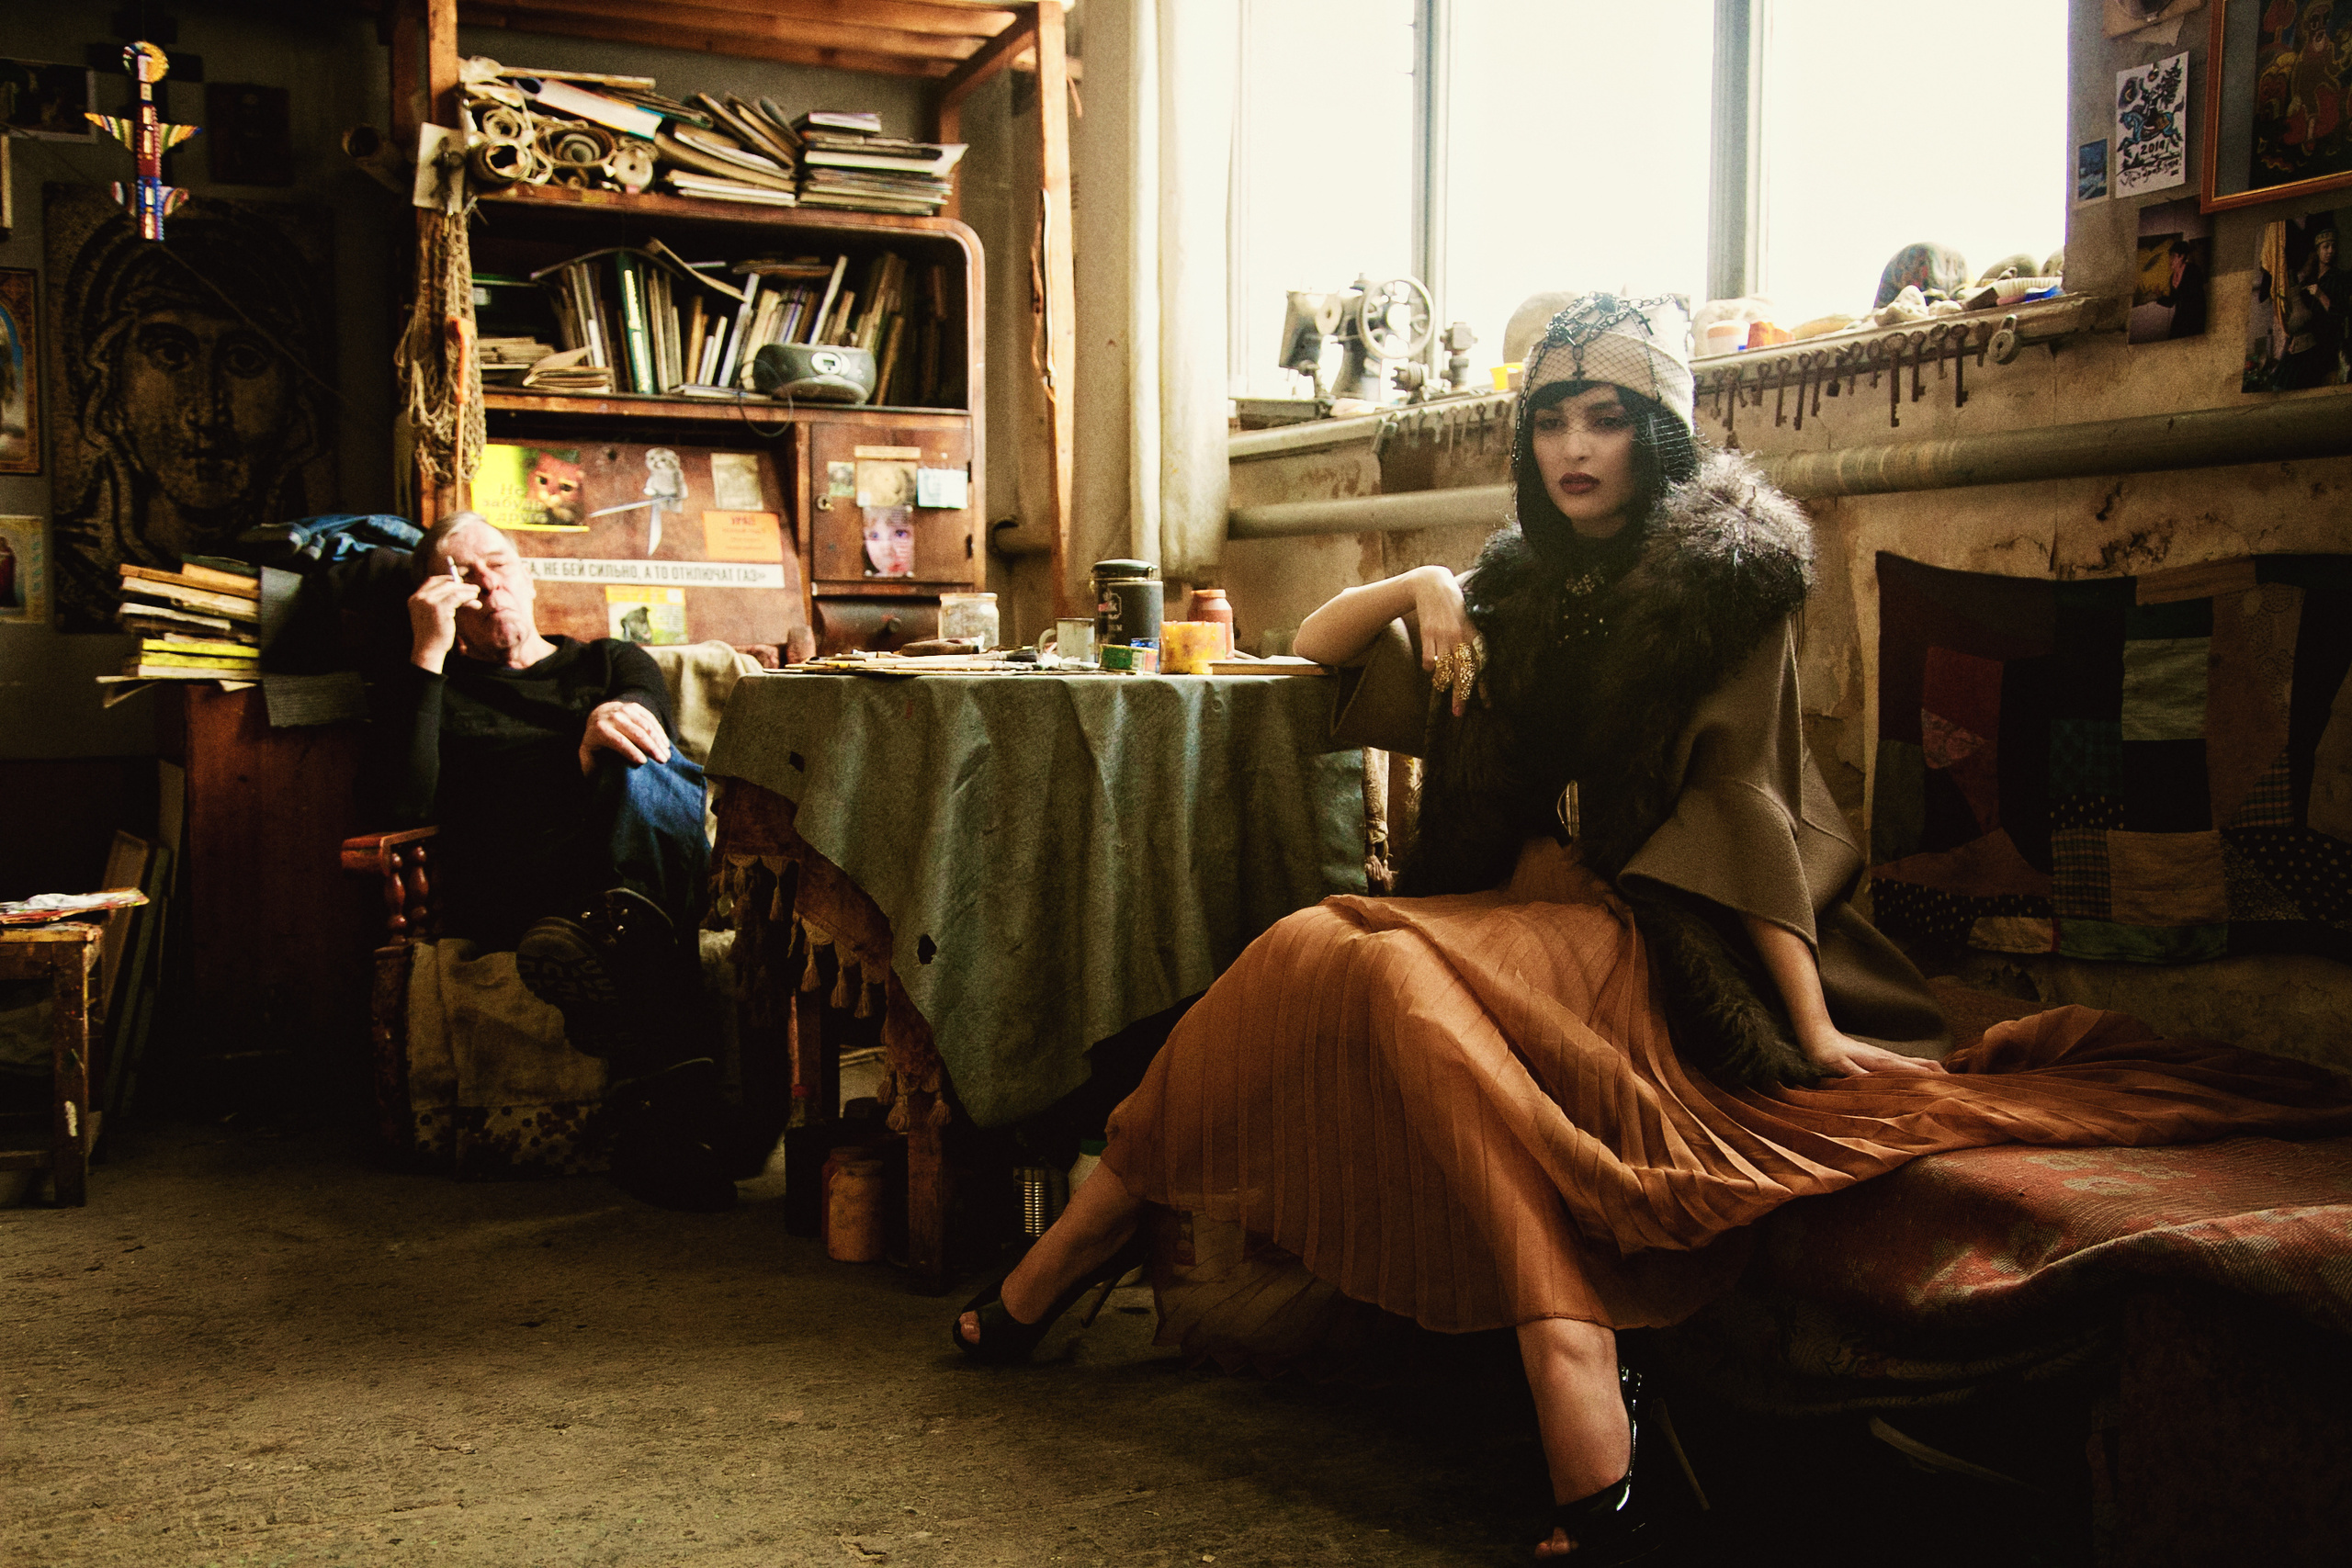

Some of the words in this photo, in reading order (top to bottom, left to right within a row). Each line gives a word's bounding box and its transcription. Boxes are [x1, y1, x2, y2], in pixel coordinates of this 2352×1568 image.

[543, 561, 558, 575] НЕ
[562, 560, 584, 576] БЕЙ
[589, 563, 641, 580] СИЛЬНО,
[645, 565, 651, 579] А
[654, 565, 668, 579] ТО
[672, 566, 732, 581] ОТКЛЮЧАТ
